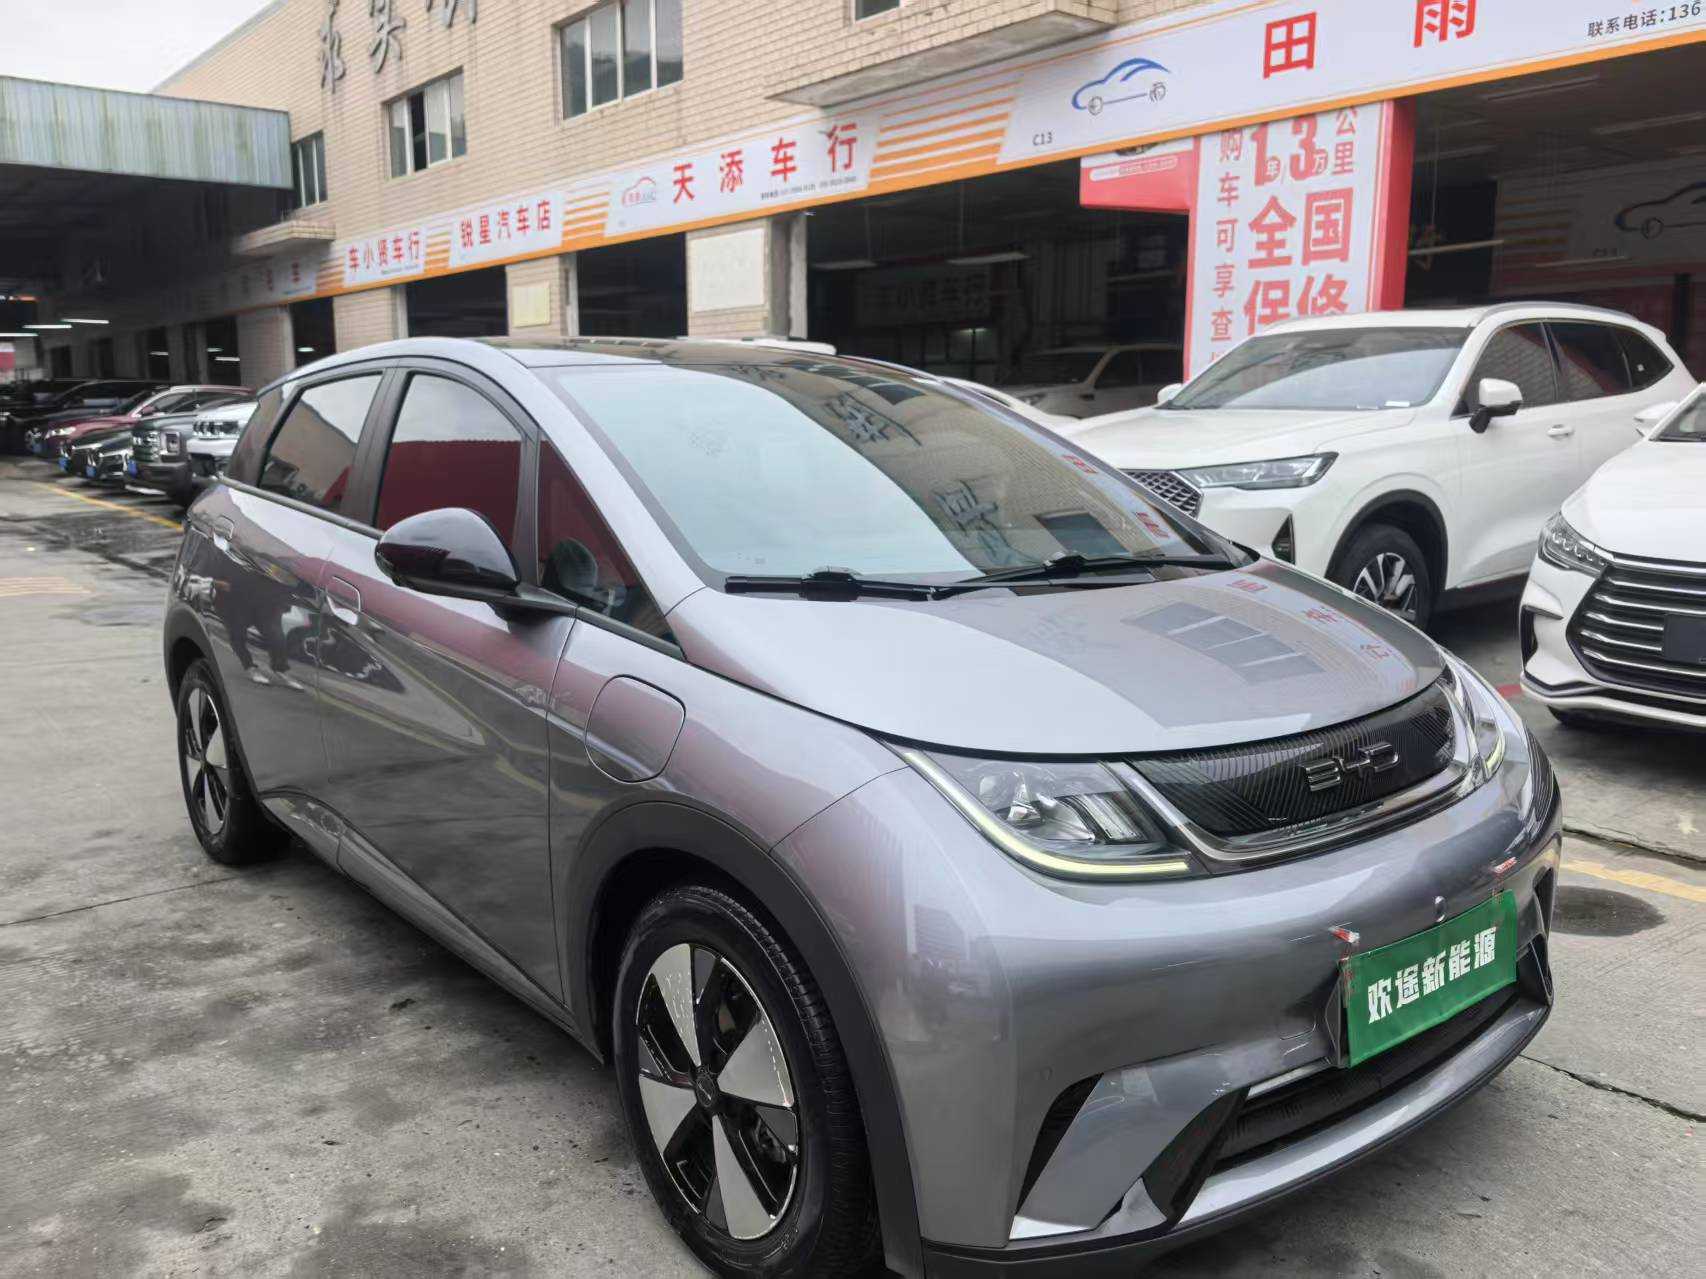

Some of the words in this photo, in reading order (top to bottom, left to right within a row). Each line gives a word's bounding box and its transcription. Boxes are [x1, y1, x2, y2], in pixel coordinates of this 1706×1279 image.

[673, 122, 858, 203] 天添车行
[1032, 131, 1054, 146] C13
[1211, 129, 1243, 360] 购车可享查
[1368, 927, 1497, 1025] 欢途新能源
